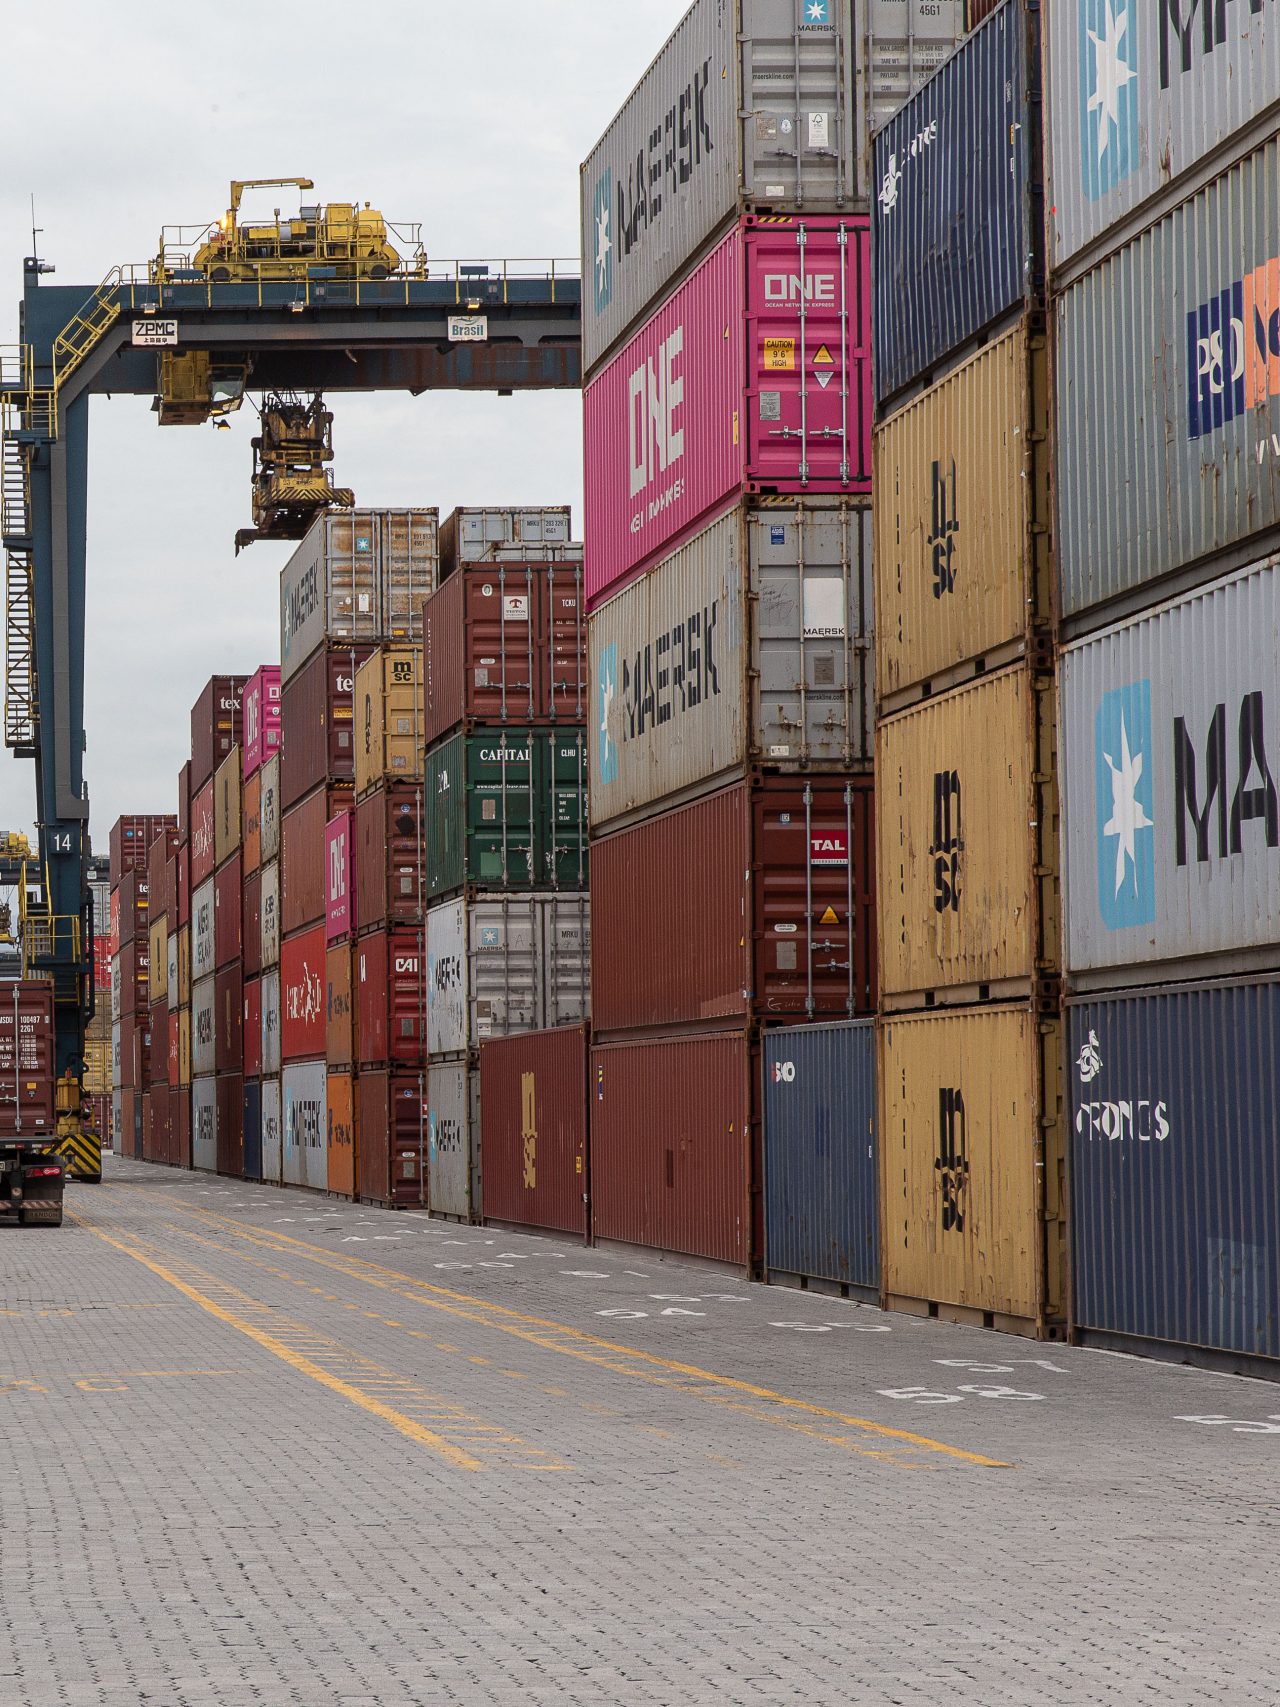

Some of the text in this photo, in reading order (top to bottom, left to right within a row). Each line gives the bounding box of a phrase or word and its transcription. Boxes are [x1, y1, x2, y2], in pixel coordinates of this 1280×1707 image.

[920, 6, 940, 16] 45G1
[764, 274, 834, 300] ONE
[136, 322, 175, 336] ZPMC
[452, 324, 484, 336] Brasil
[766, 340, 792, 348] CAUTION
[804, 627, 845, 635] MAERSK
[622, 598, 722, 742] MAERSK
[336, 674, 353, 692] te
[220, 697, 240, 709] tex
[561, 749, 576, 757] CLHU
[54, 834, 72, 851] 14
[811, 840, 846, 851] TAL
[395, 958, 418, 972] CAI
[433, 1262, 515, 1270] 50
[593, 1306, 706, 1320] 54
[767, 1321, 892, 1332] 55
[931, 1358, 1071, 1373] 57
[875, 1384, 1046, 1404] 58
